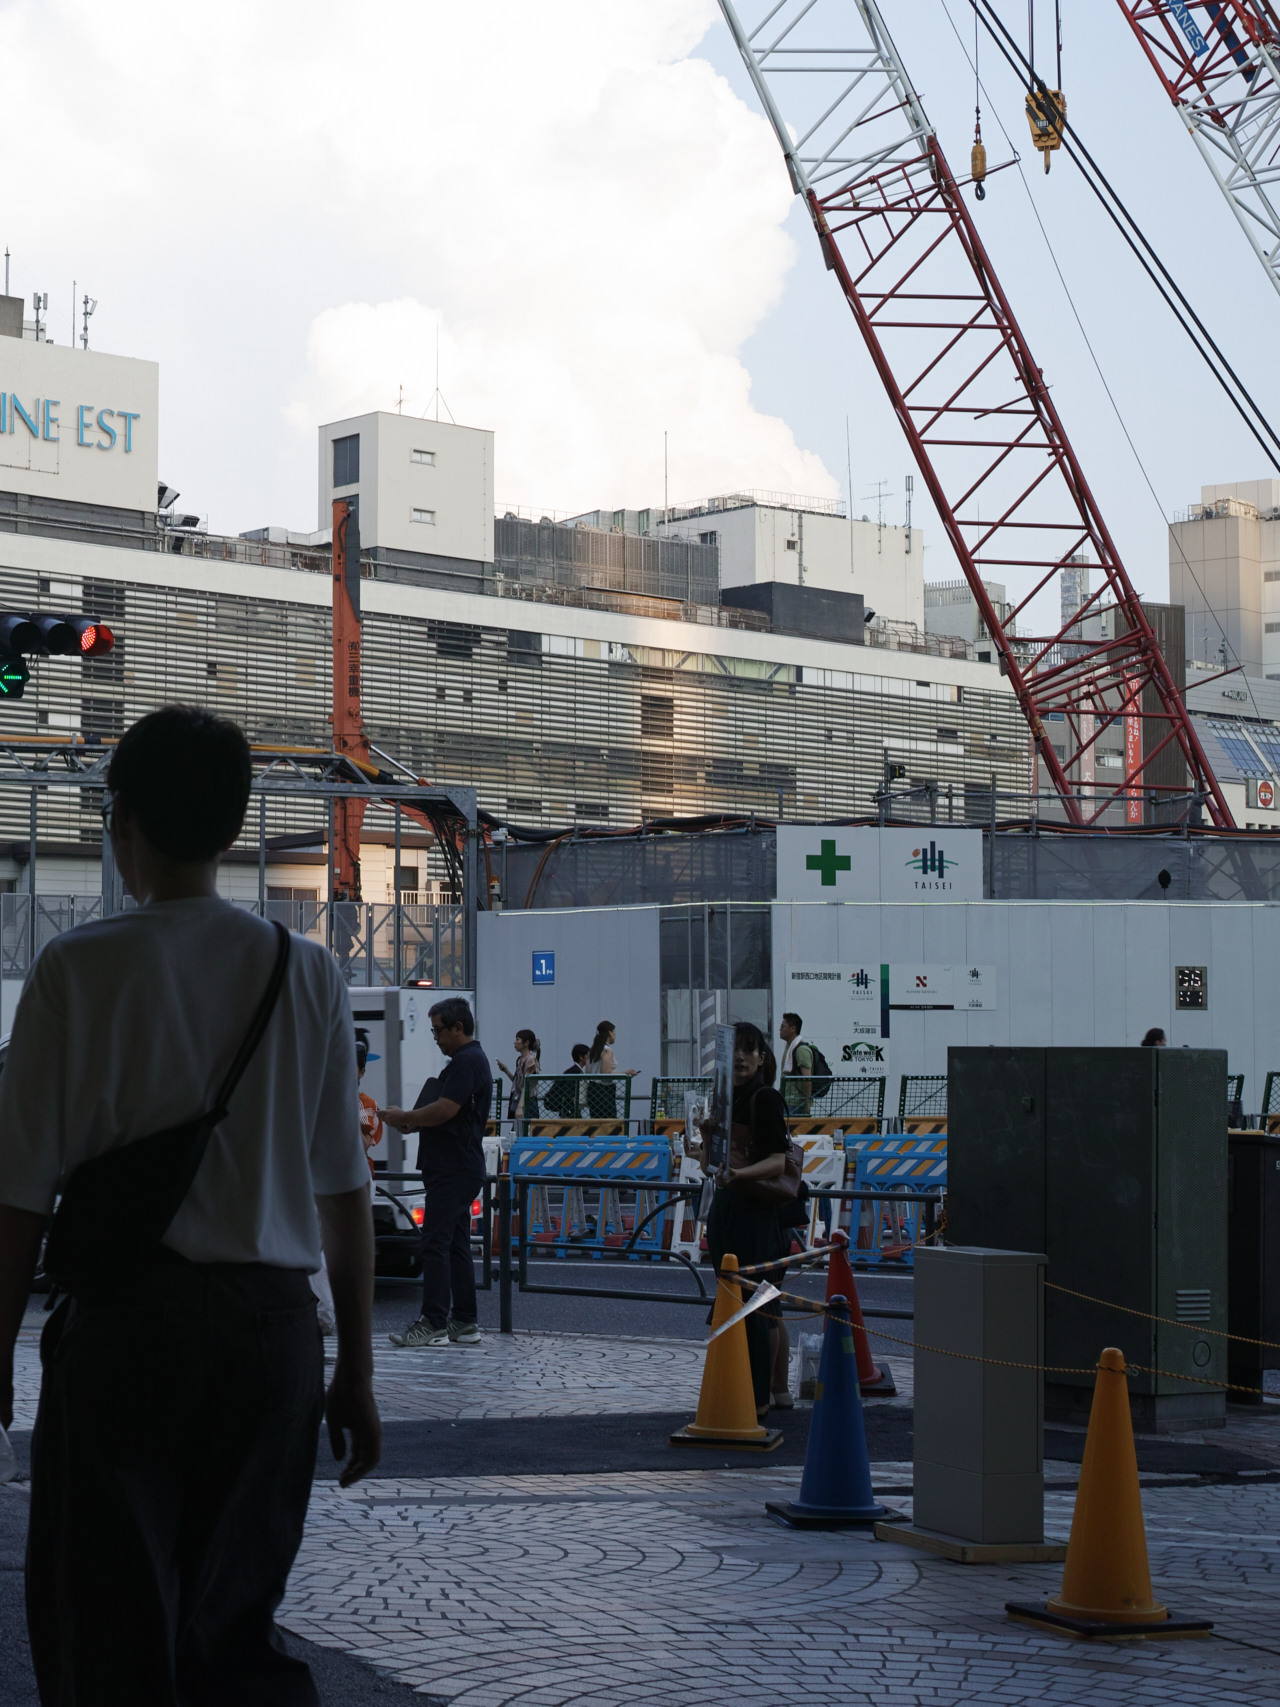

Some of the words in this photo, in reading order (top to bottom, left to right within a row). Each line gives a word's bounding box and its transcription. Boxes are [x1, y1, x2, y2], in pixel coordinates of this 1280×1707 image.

[1166, 0, 1205, 51] ANES
[78, 404, 141, 453] EST
[914, 881, 952, 890] TAISEI
